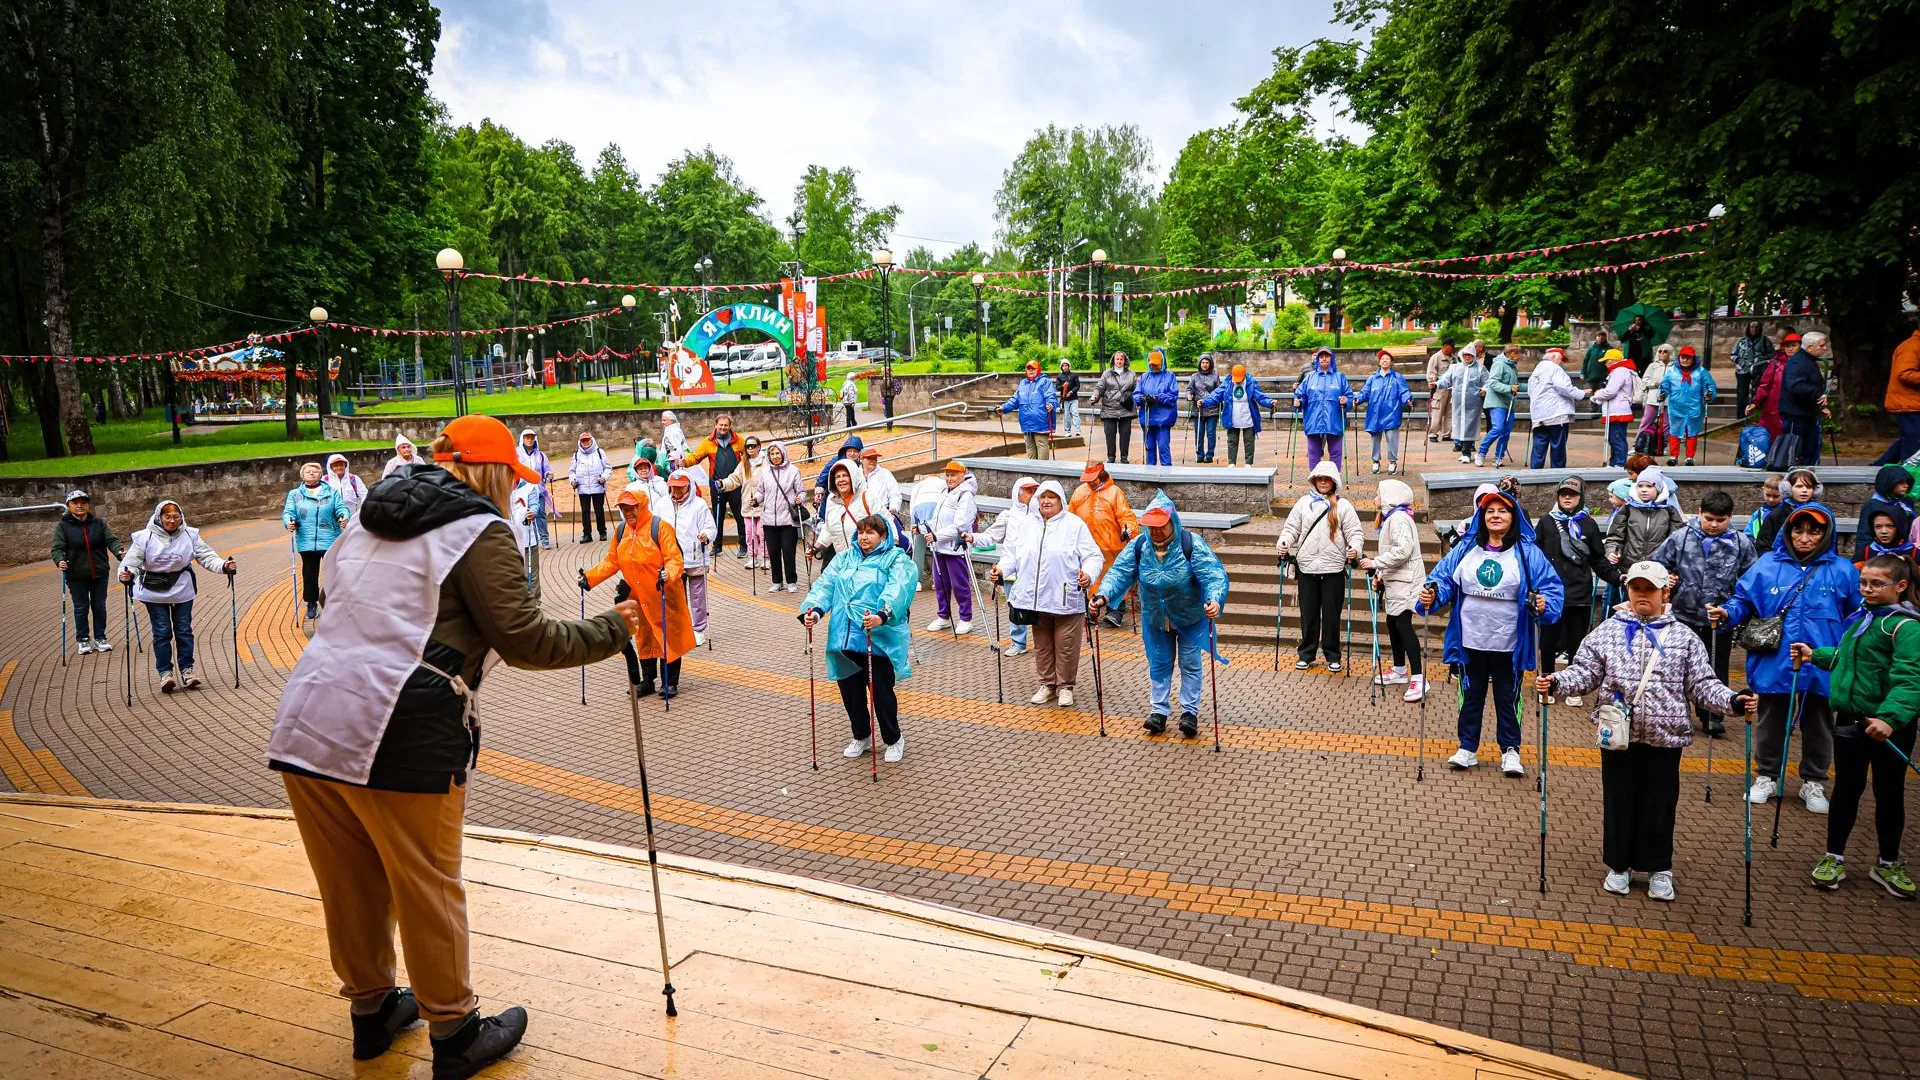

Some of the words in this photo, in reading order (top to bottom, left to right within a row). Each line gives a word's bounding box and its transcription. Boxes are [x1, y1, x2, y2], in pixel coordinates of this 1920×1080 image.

[806, 301, 814, 314] 9
[703, 320, 717, 337] Я
[734, 305, 791, 335] КЛИН
